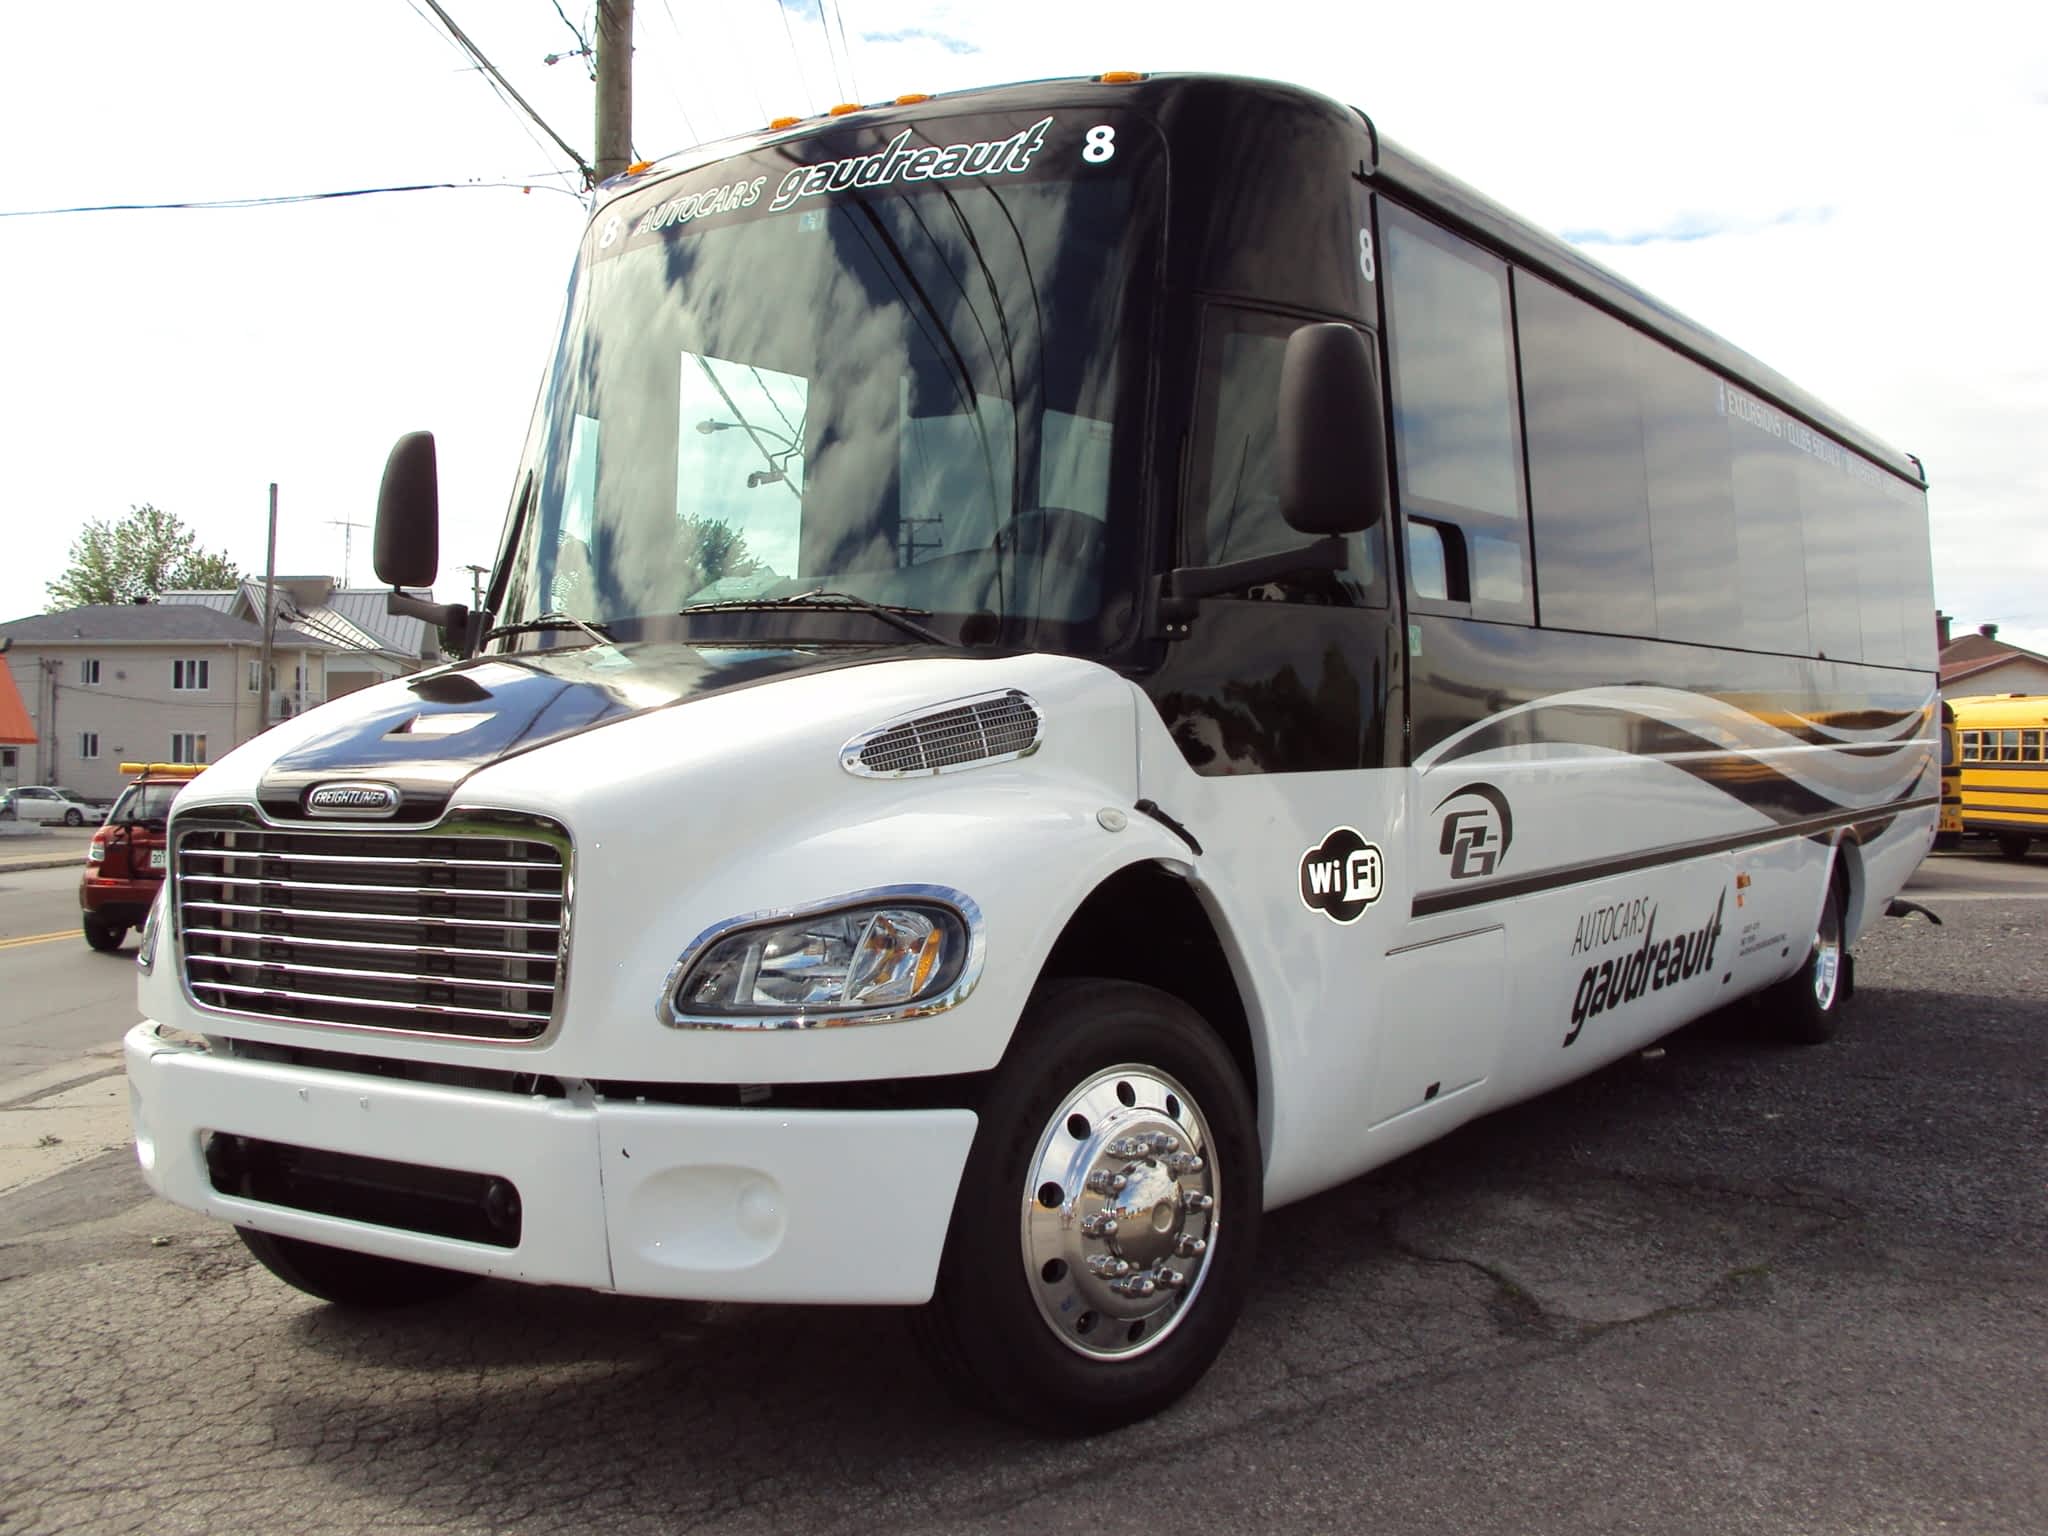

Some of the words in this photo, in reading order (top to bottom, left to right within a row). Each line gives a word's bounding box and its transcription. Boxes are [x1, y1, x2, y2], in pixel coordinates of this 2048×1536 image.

[1081, 125, 1116, 164] 8
[632, 175, 768, 237] AUTOCARS
[768, 116, 1054, 212] gaudreault
[600, 216, 622, 248] 8
[1359, 228, 1376, 282] 8
[314, 790, 385, 805] FREIGHTLINER
[1571, 896, 1649, 957] AUTOCARS
[1562, 884, 1727, 1048] gaudreault
